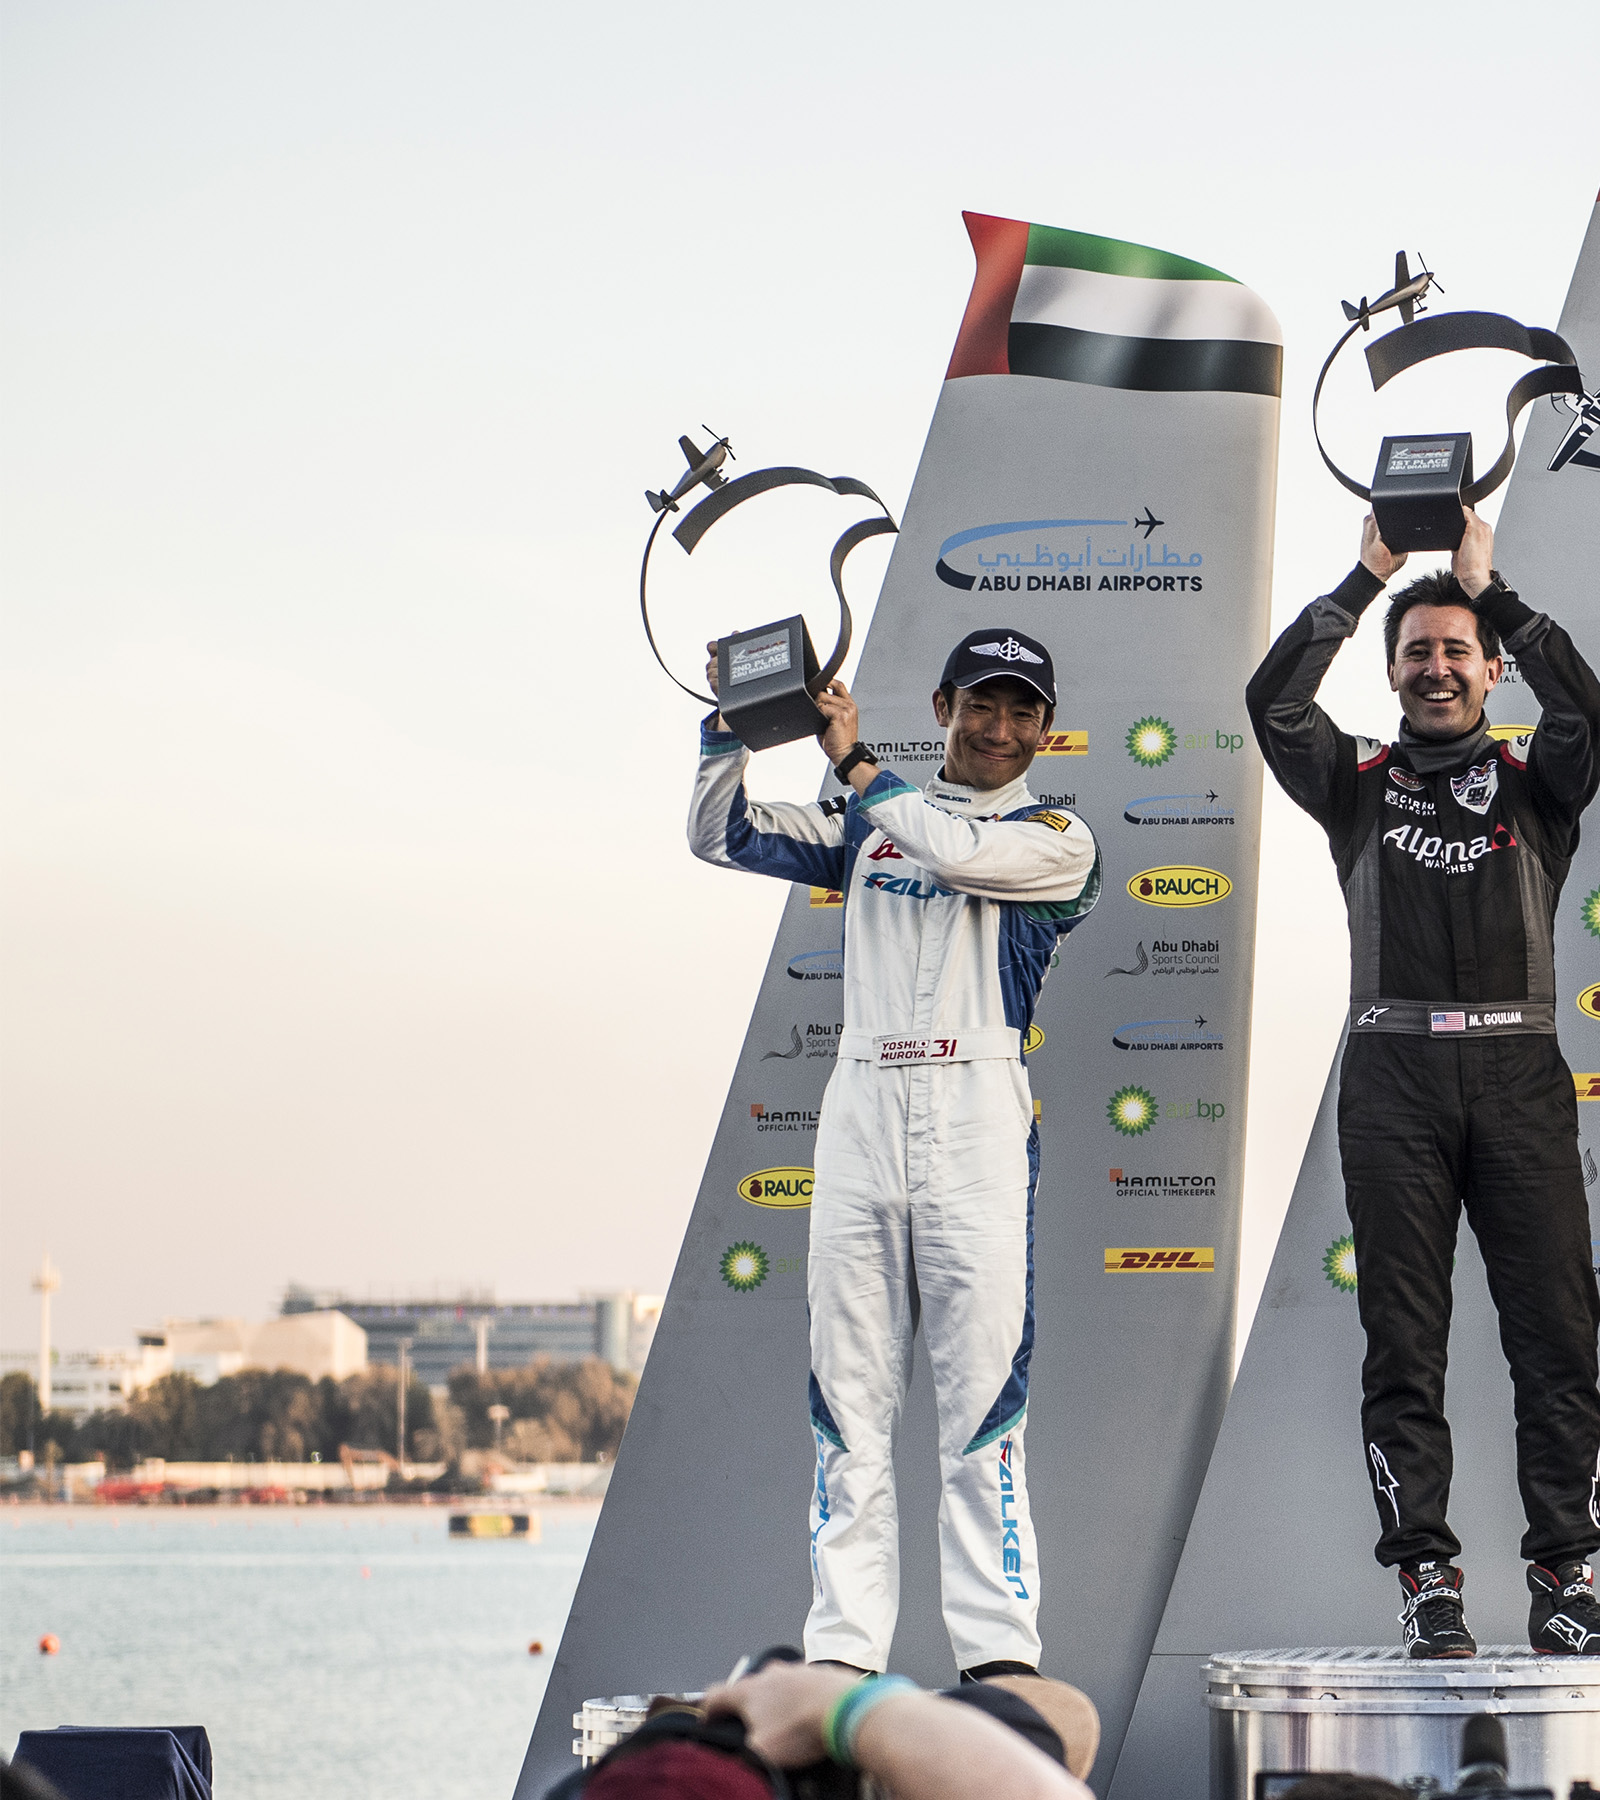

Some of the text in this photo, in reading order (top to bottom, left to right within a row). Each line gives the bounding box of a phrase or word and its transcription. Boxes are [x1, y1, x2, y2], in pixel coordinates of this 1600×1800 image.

[1413, 458, 1449, 466] PLACE
[977, 536, 1203, 573] مطارات أبوظبي
[978, 576, 1203, 591] ABU DHABI AIRPORTS
[731, 652, 788, 674] 2ND PLACE
[1216, 730, 1243, 753] bp
[893, 754, 945, 762] TIMEKEEPER
[1039, 794, 1076, 805] Dhabi
[1155, 879, 1218, 895] RAUCH
[1152, 940, 1219, 952] Abu Dhabi
[1152, 954, 1219, 966] Sports Council
[1469, 1012, 1522, 1026] M. GOULIAN
[806, 1024, 831, 1036] Abu
[806, 1038, 836, 1048] Sports
[882, 1039, 957, 1057] YOSHI 31
[880, 1050, 926, 1060] MUROYA
[1197, 1099, 1225, 1122] bp
[757, 1124, 798, 1132] OFFICIAL
[765, 1179, 815, 1196] RAUC
[1116, 1176, 1216, 1187] HAMILTON
[1162, 1188, 1216, 1196] TIMEKEEPER
[1119, 1252, 1200, 1269] DHL
[1000, 1434, 1029, 1599] FALKEN
